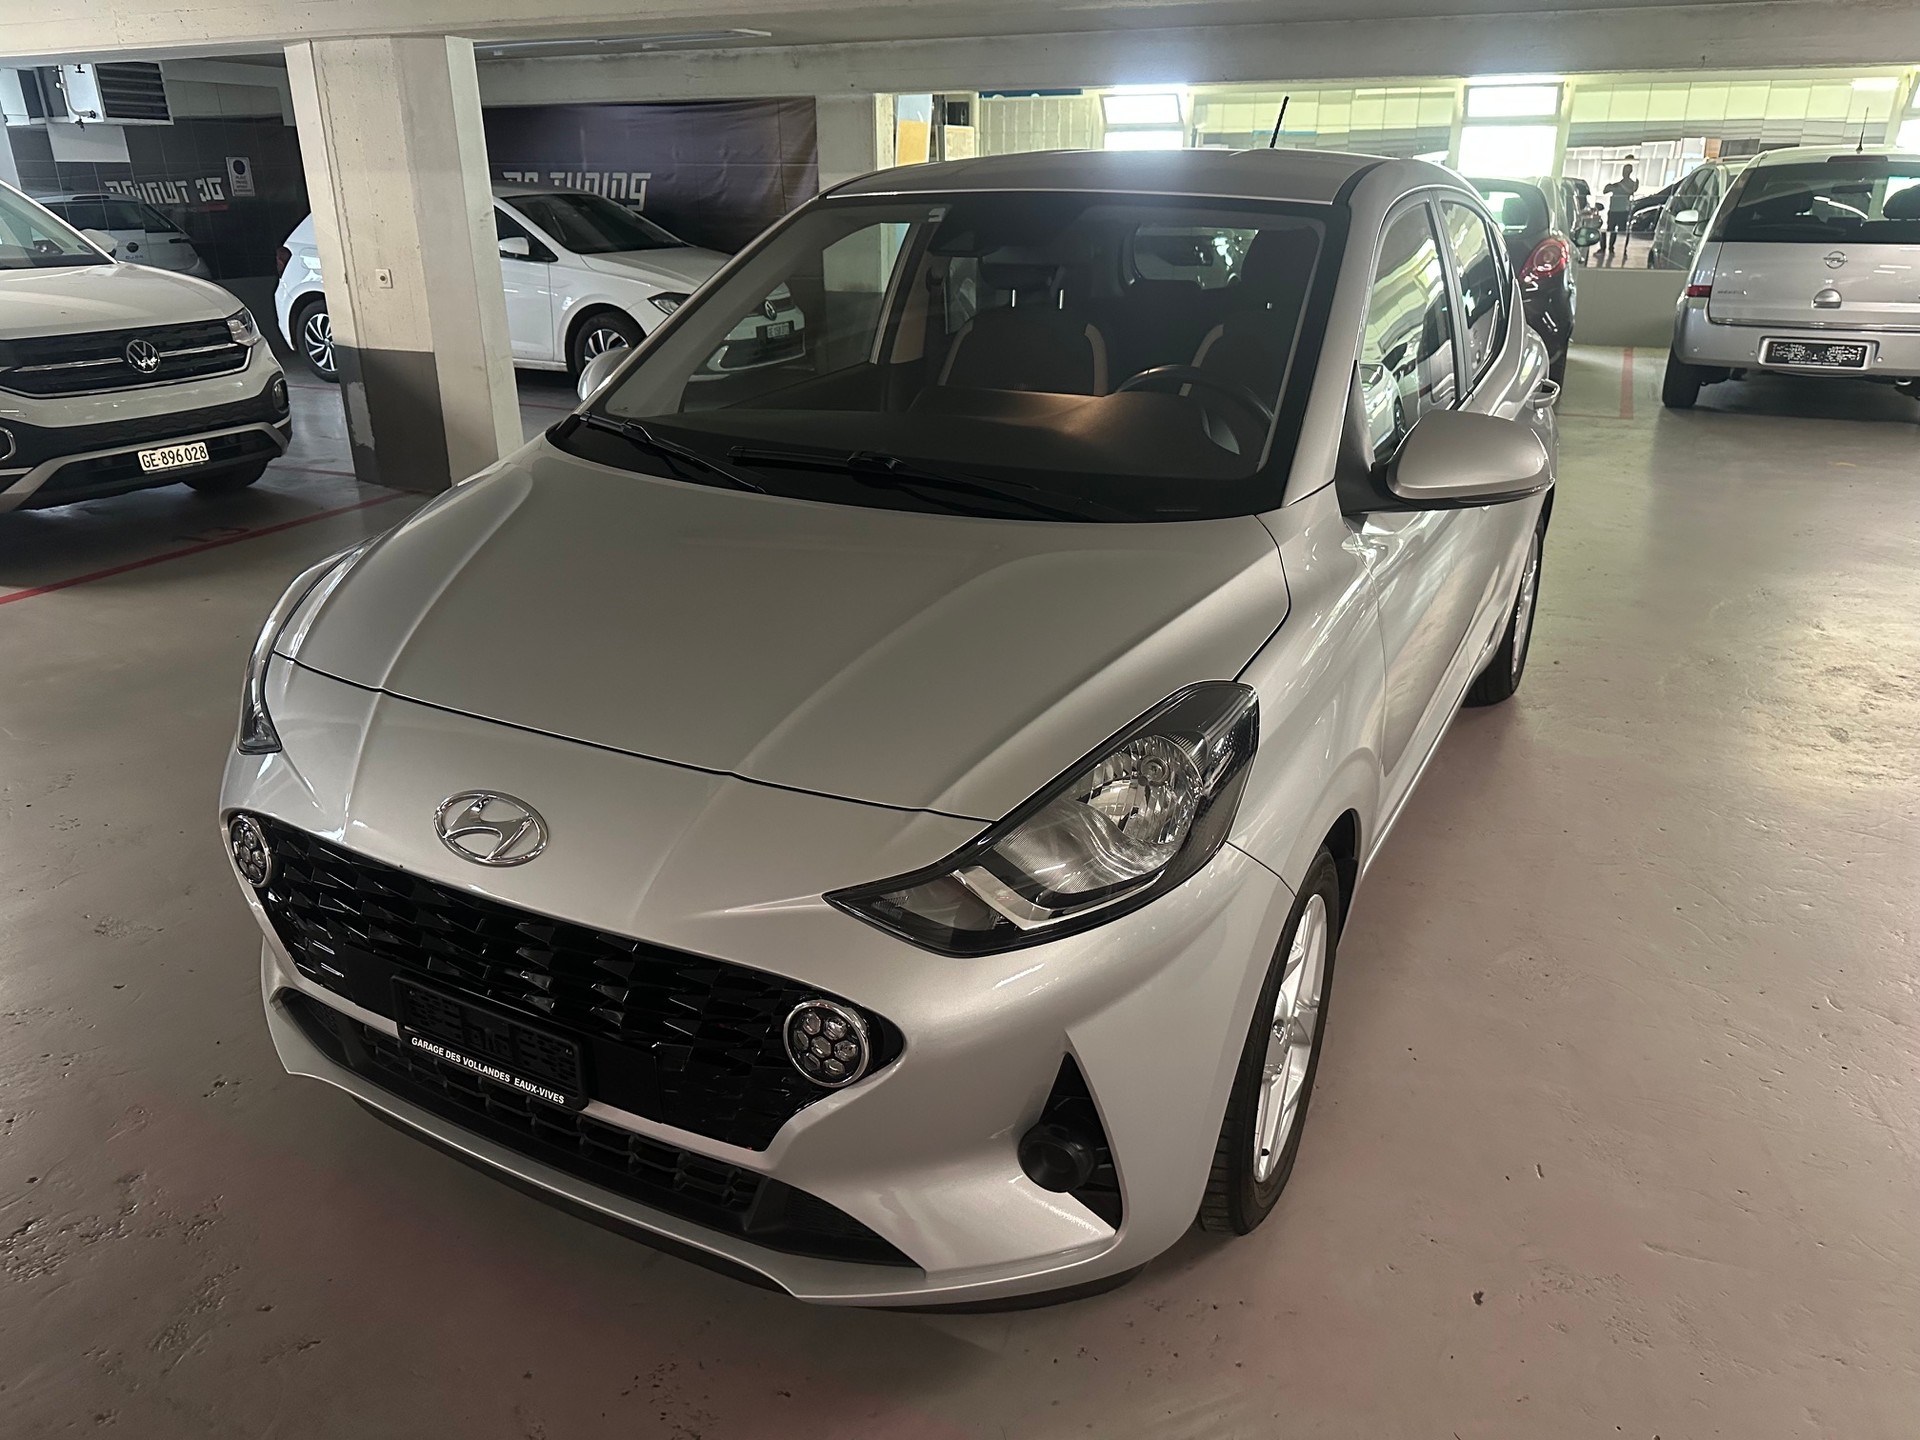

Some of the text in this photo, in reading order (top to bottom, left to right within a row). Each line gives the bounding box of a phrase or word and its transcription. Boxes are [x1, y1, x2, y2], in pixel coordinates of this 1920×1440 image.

[411, 1037, 565, 1104] GARAGE DES VOLLANDES EAUX-VIVES
